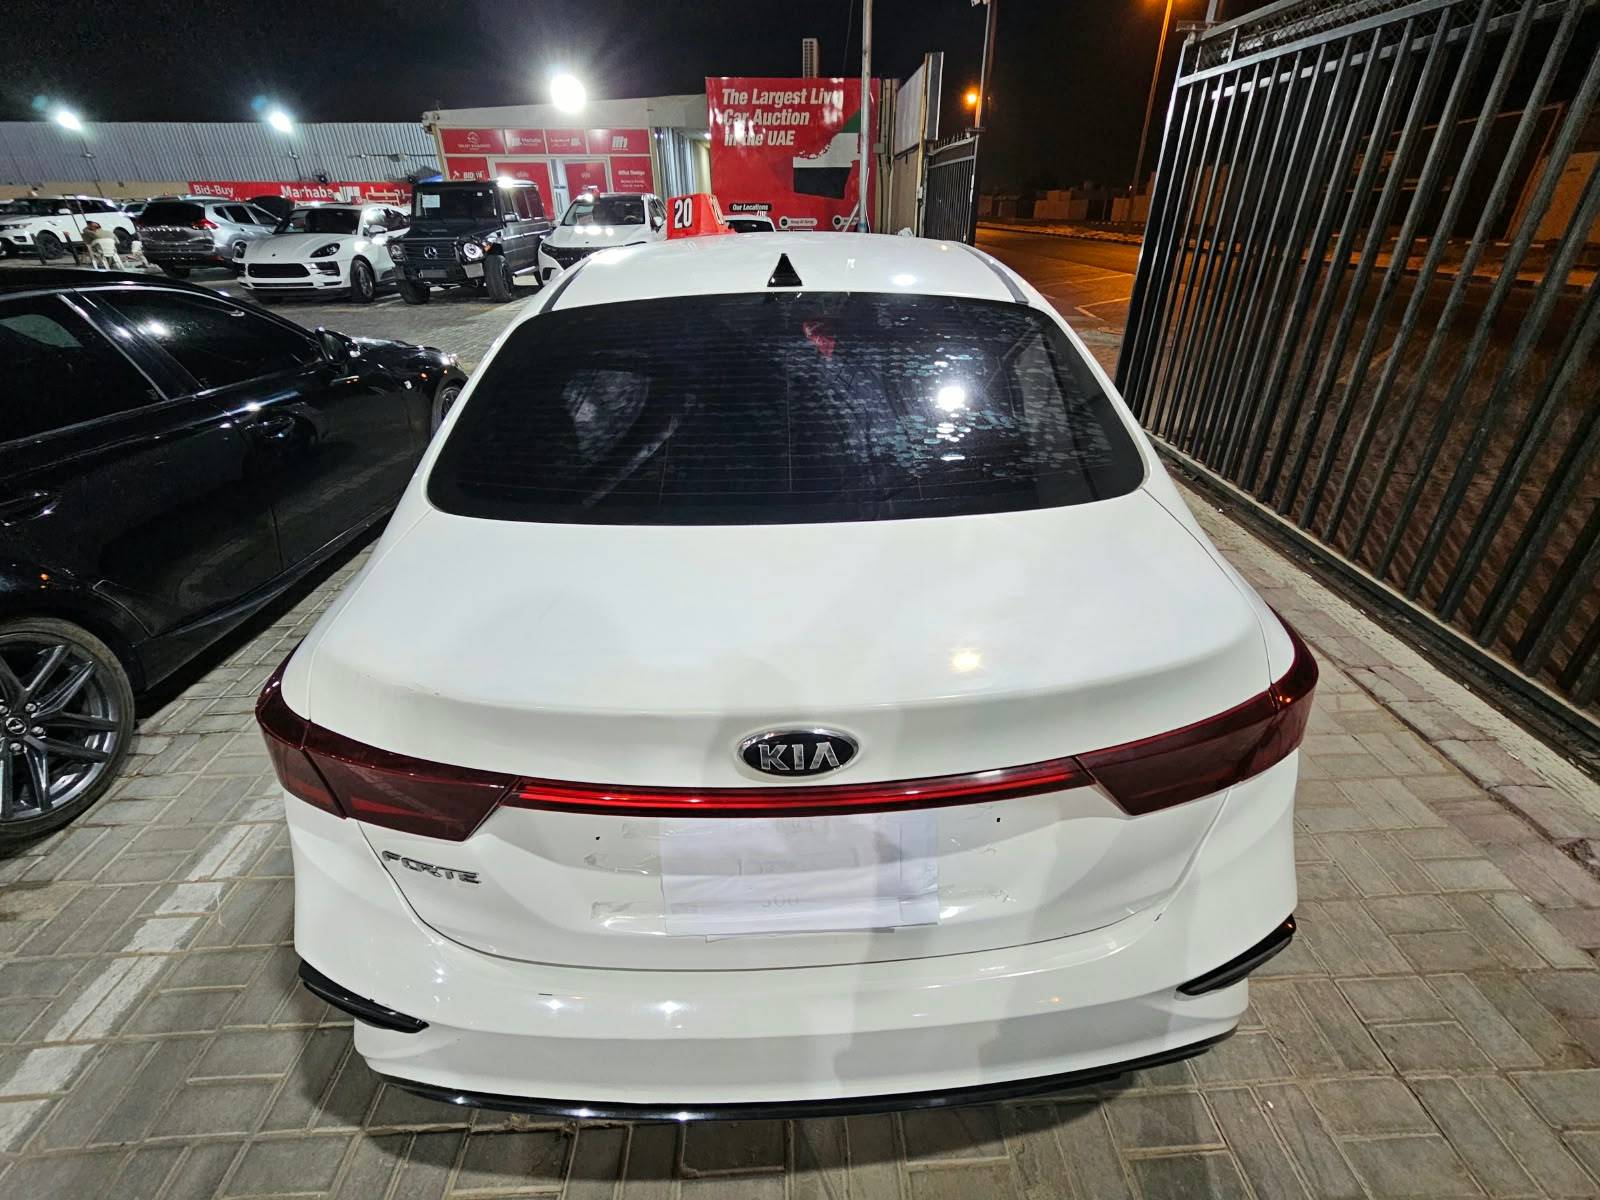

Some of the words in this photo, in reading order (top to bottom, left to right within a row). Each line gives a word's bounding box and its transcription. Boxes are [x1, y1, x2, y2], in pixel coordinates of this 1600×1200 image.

[722, 88, 748, 105] The
[752, 88, 807, 108] Largest
[723, 109, 749, 126] Car
[753, 109, 810, 125] Auction
[768, 130, 795, 146] UAE
[193, 184, 234, 198] Bid-Buy
[674, 198, 693, 229] 20
[732, 203, 741, 211] Our
[743, 203, 769, 211] Locations
[758, 742, 840, 770] KIA
[382, 850, 482, 884] FORTE
